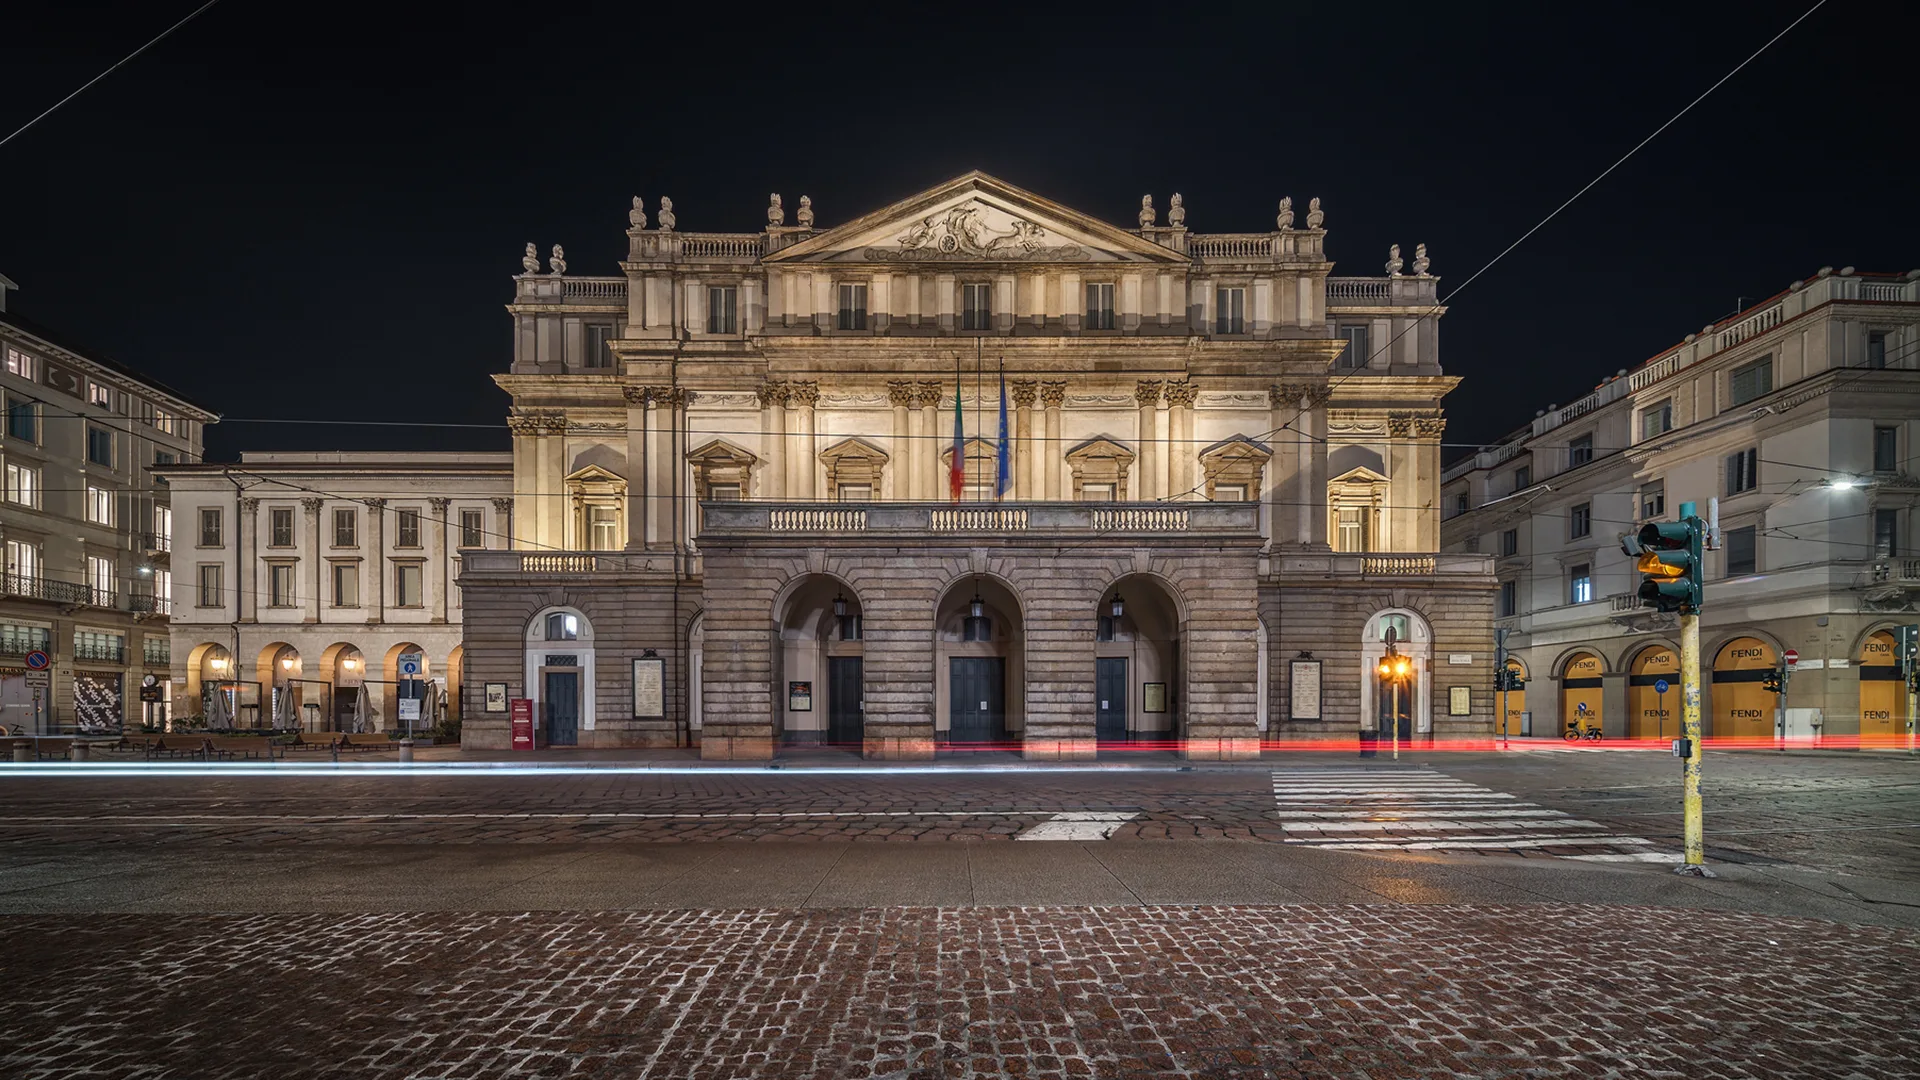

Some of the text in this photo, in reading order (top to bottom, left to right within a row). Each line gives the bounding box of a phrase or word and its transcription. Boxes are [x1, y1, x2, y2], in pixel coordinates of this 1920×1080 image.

[1864, 643, 1891, 652] FENDI
[1731, 648, 1763, 658] FENDI
[1644, 655, 1670, 664] FENDI
[1574, 661, 1596, 669] FENDI
[1644, 709, 1670, 717] FENDI
[1731, 709, 1762, 718] FENDI
[1863, 710, 1890, 719] FENDI
